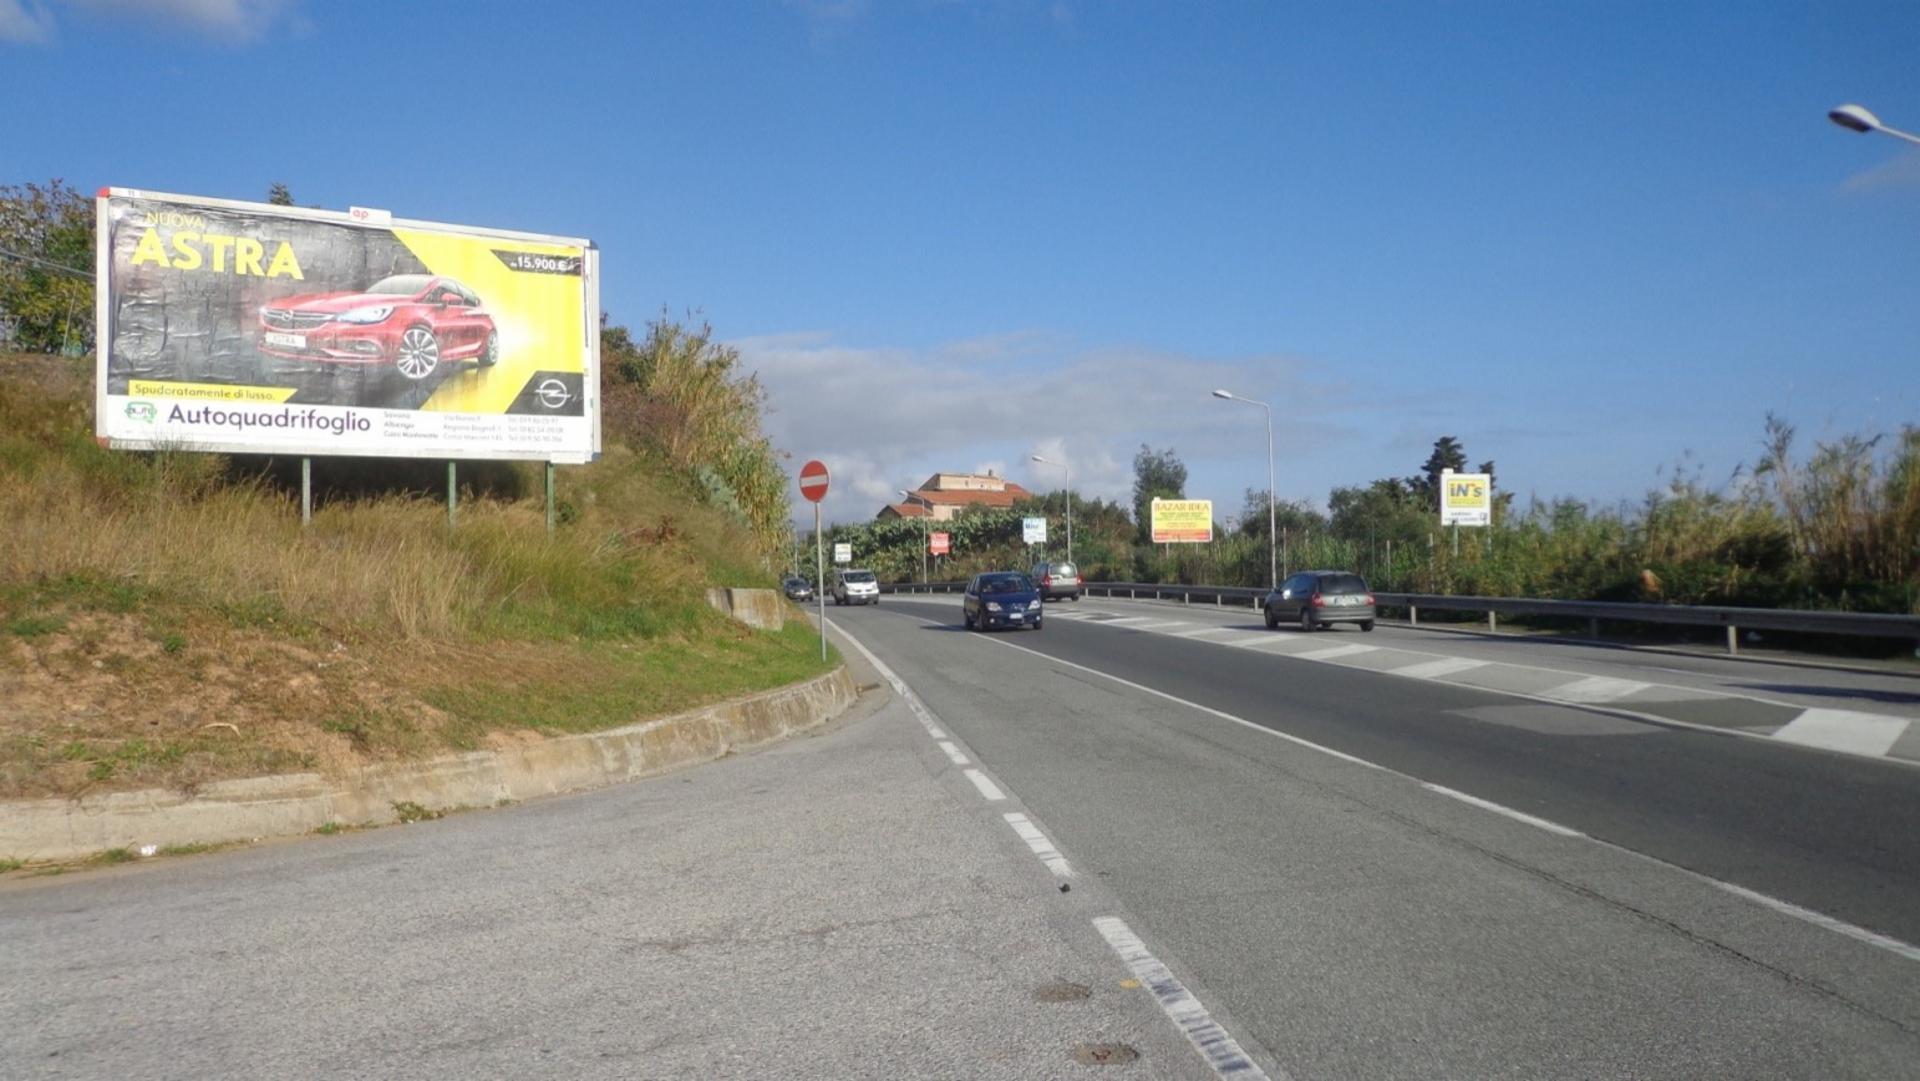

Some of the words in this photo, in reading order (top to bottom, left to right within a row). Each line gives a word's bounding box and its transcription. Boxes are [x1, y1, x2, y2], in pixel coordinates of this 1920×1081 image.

[147, 212, 205, 228] NUOVA
[130, 228, 304, 280] ASTRA
[517, 256, 556, 270] 15.900
[135, 384, 231, 399] Spudoratamente
[233, 390, 243, 399] di
[245, 391, 276, 401] lusso.
[168, 403, 371, 435] Autoquadrifoglio
